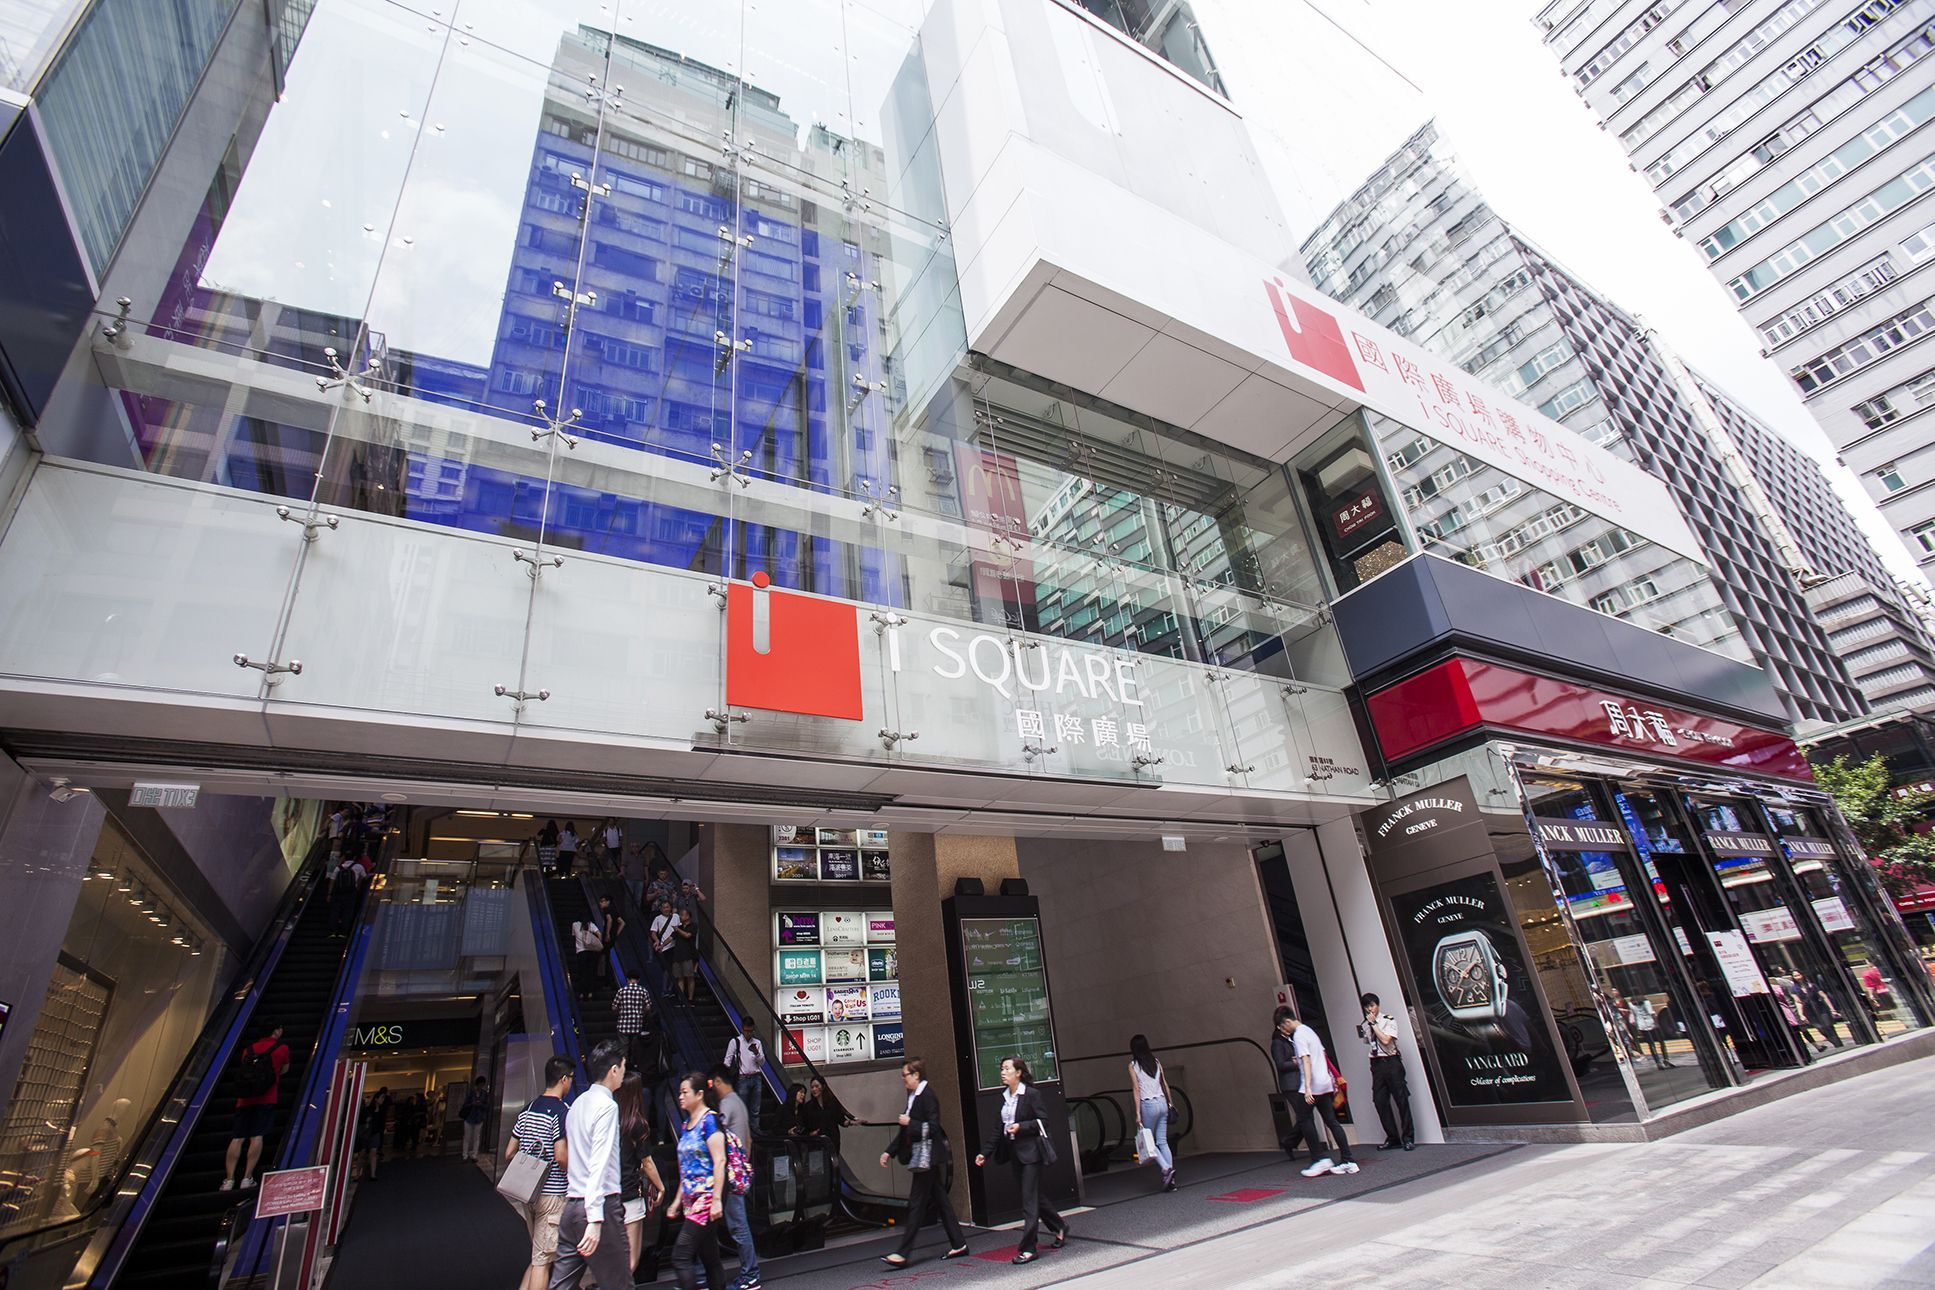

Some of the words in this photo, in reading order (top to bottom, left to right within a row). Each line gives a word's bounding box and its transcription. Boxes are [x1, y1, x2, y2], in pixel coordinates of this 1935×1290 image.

[1351, 331, 1604, 484] 國際廣場購物中心
[1433, 405, 1512, 460] SQUARE
[1514, 446, 1581, 496] Shopping
[1577, 479, 1622, 512] Centre
[1340, 496, 1373, 523] 周大福
[929, 627, 1143, 706] SQUARE
[1015, 708, 1152, 755] 國際廣場
[1599, 700, 1677, 747] 周大福
[1320, 764, 1343, 774] NATHAN
[1343, 767, 1359, 776] ROAD
[1378, 804, 1414, 838] FRANCK
[1415, 798, 1463, 813] MULLER
[1405, 818, 1438, 835] GENEVE
[1574, 827, 1625, 844] MULLER
[1736, 837, 1771, 852] MULLER
[1805, 842, 1835, 855] MULLER
[1414, 899, 1444, 924] FRANCK
[1444, 896, 1485, 910] MULLER
[1437, 912, 1464, 924] GENEVE
[354, 1025, 403, 1045] M&S
[1465, 1052, 1529, 1070] VANGUARD
[1470, 1076, 1493, 1086] Master
[1494, 1076, 1502, 1087] of
[1501, 1074, 1536, 1086] complications
